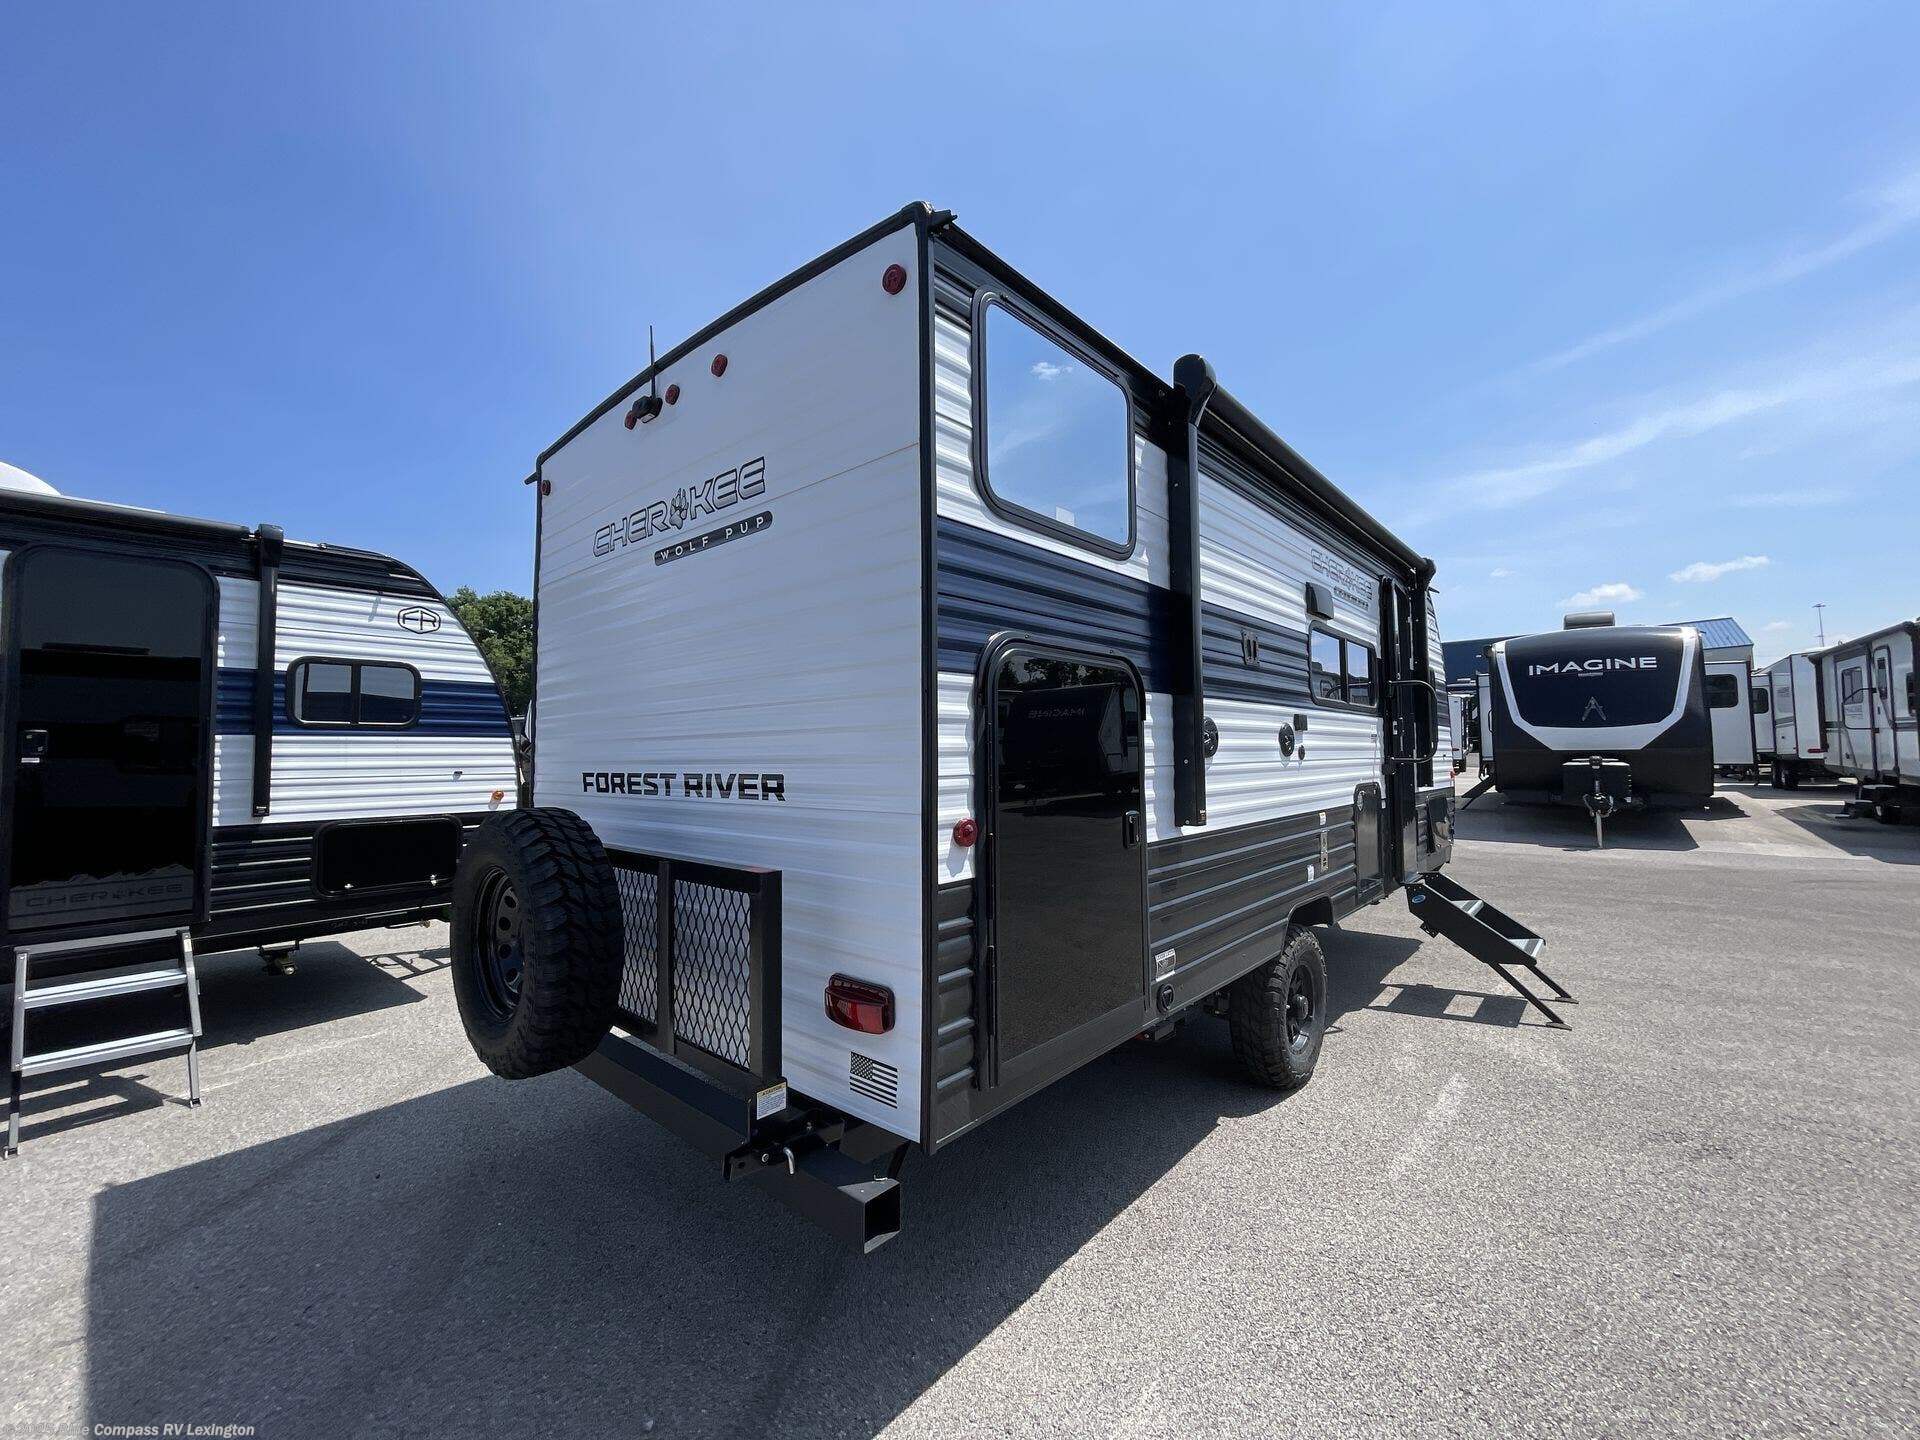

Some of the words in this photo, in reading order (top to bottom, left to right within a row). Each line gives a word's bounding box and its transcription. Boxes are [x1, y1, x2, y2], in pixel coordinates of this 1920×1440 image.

[660, 535, 709, 560] WOLF
[725, 516, 764, 540] PUP
[1528, 656, 1657, 676] IMAGINE
[582, 772, 677, 797] FOREST
[683, 773, 786, 801] RIVER
